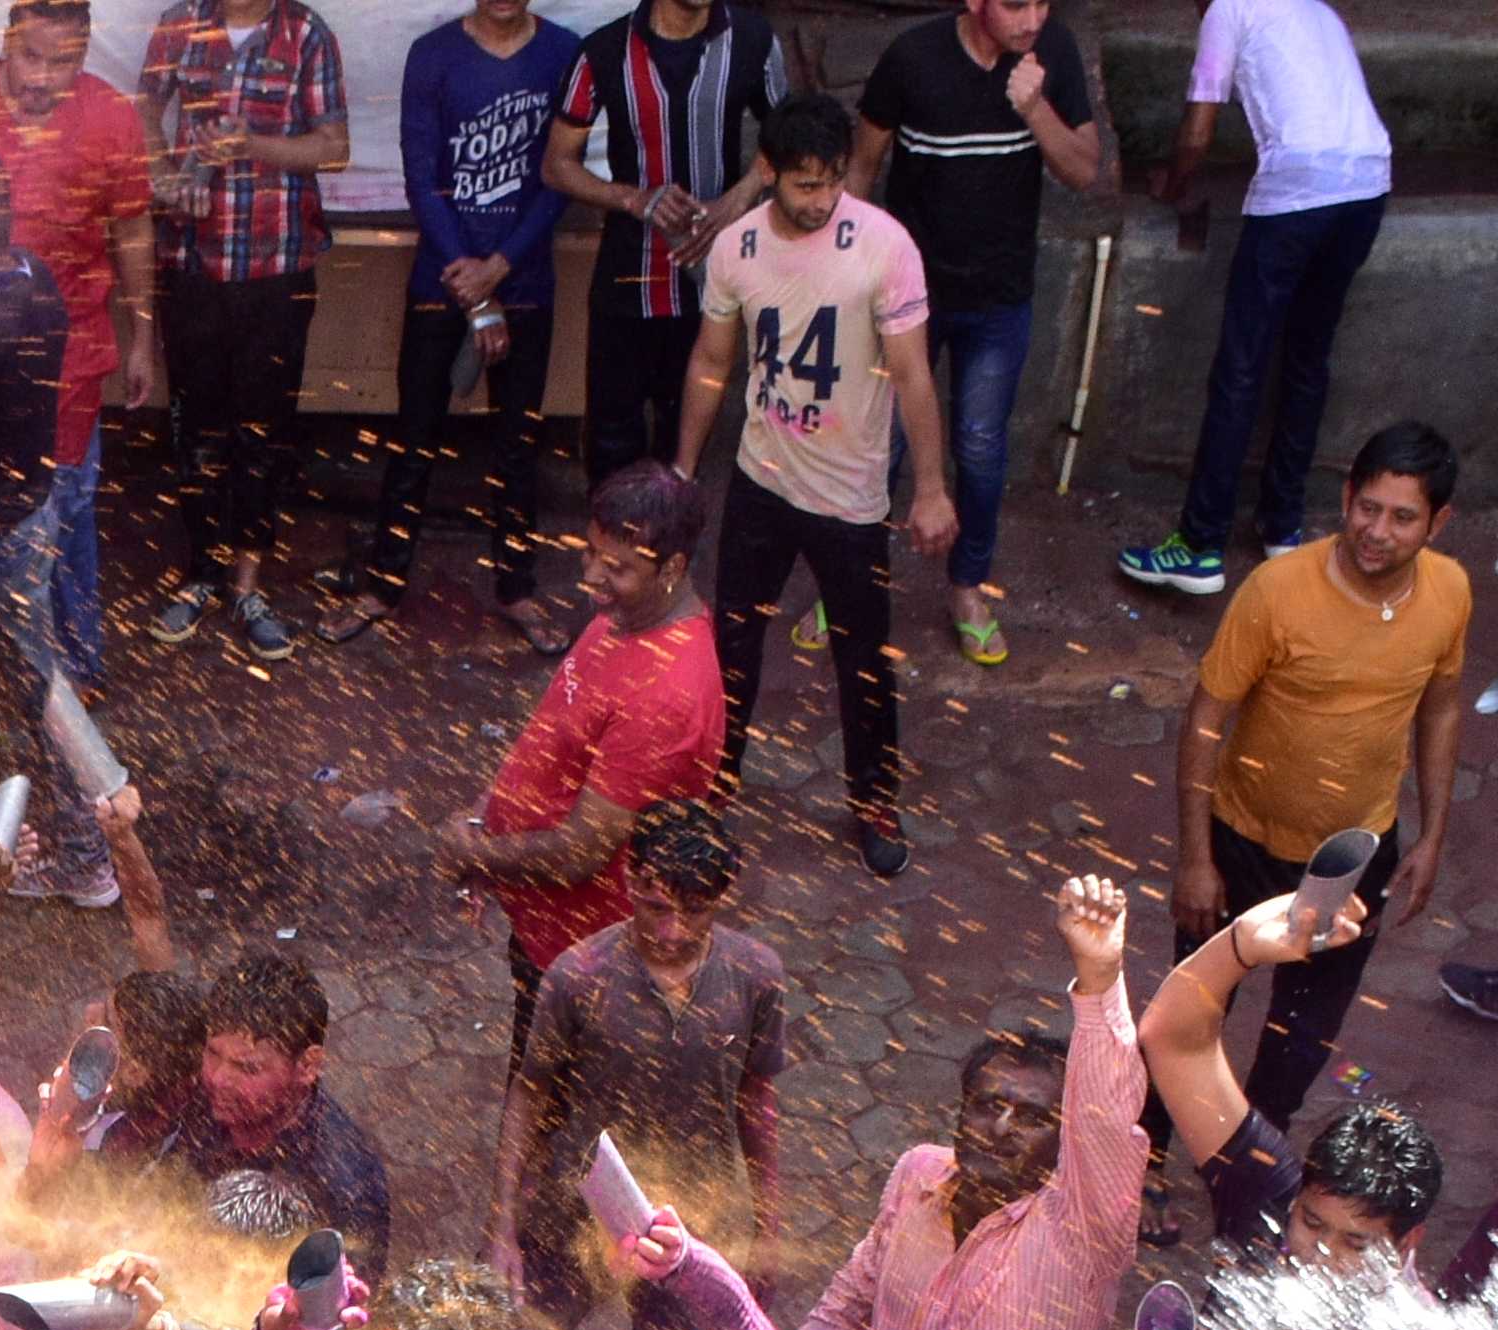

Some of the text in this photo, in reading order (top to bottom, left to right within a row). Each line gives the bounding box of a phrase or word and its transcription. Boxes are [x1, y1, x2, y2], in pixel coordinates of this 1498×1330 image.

[449, 109, 550, 167] TODAY
[458, 92, 549, 136] SOMETHING
[755, 305, 841, 401] 44
